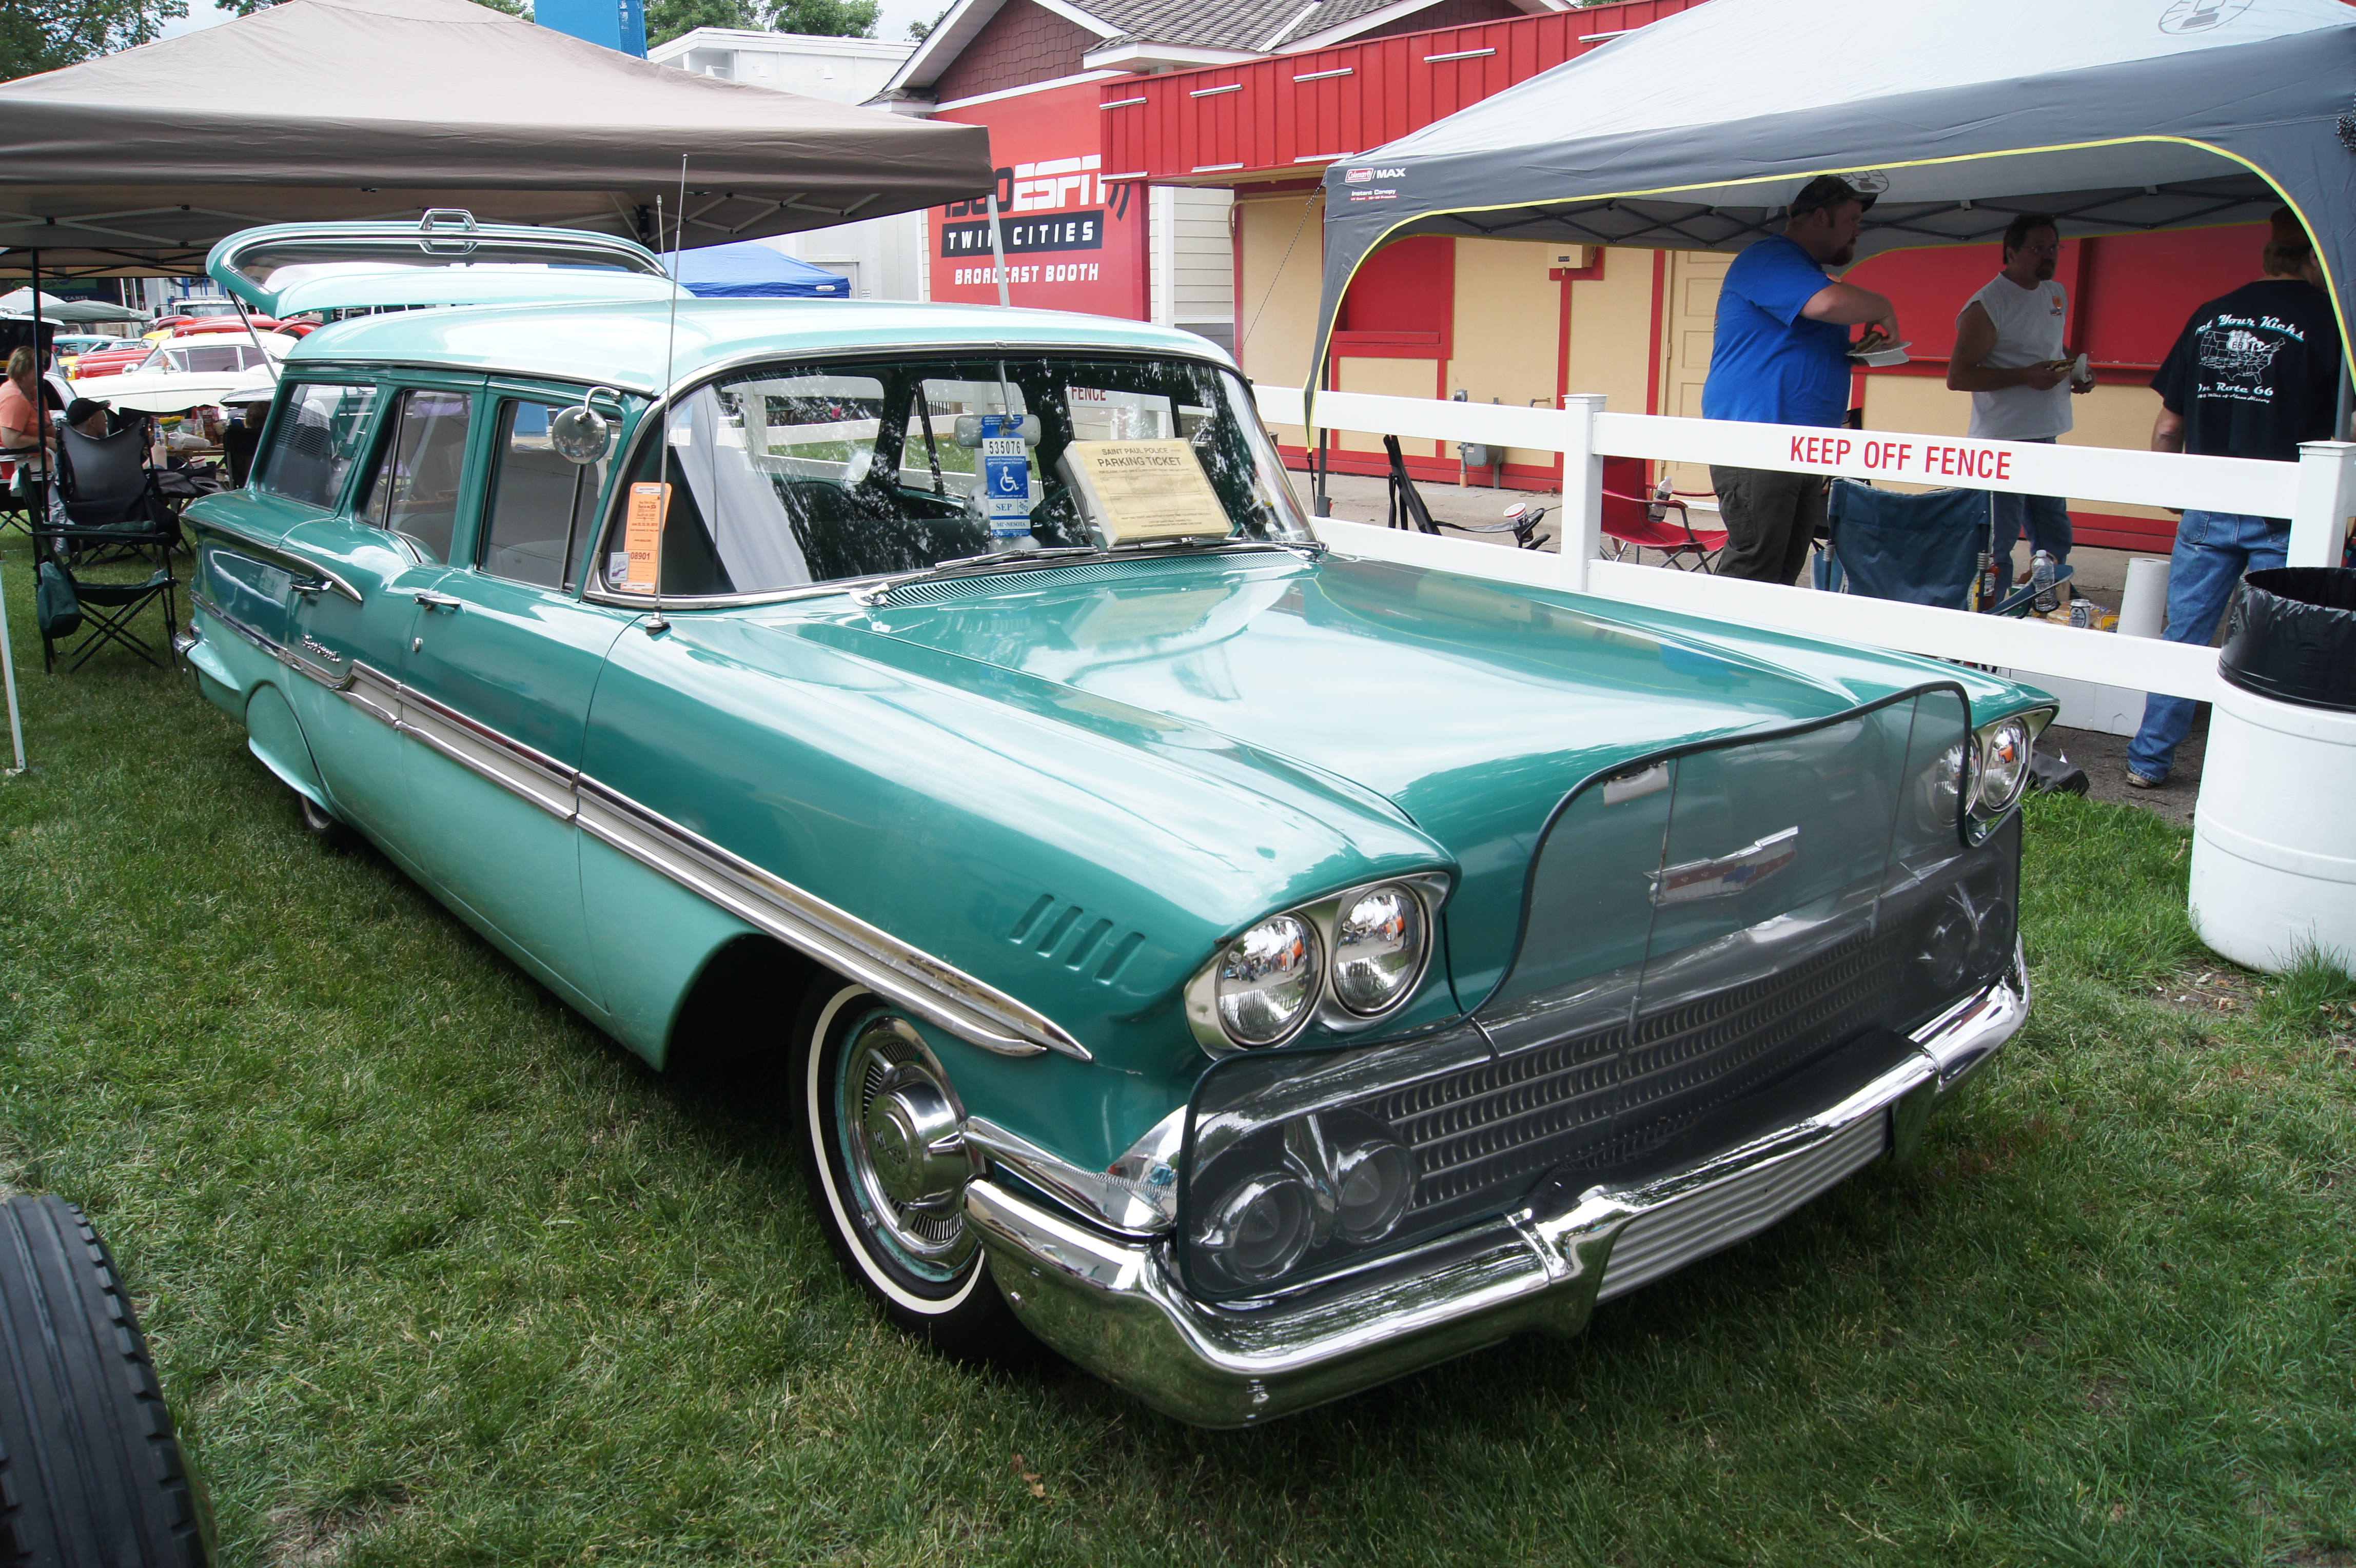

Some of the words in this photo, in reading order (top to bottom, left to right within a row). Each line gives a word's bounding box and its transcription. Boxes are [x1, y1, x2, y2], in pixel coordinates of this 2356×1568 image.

[1348, 170, 1367, 179] Coleman
[1377, 168, 1406, 179] MAX
[1013, 154, 1106, 211] ESPN
[1013, 221, 1093, 245] CITIES
[1045, 263, 1098, 282] BOOTH
[2217, 314, 2255, 327] Your
[2259, 316, 2305, 342] Kicks
[1071, 386, 1106, 401] FENCE
[2253, 385, 2274, 396] 66
[989, 441, 1020, 454] 535076
[1097, 457, 1145, 467] PARKING
[1145, 457, 1182, 465] TICKET
[1791, 436, 1851, 465] KEEP
[1864, 441, 1912, 471] OFF
[1925, 446, 2012, 480] FENCE
[1019, 501, 1029, 512] 2012
